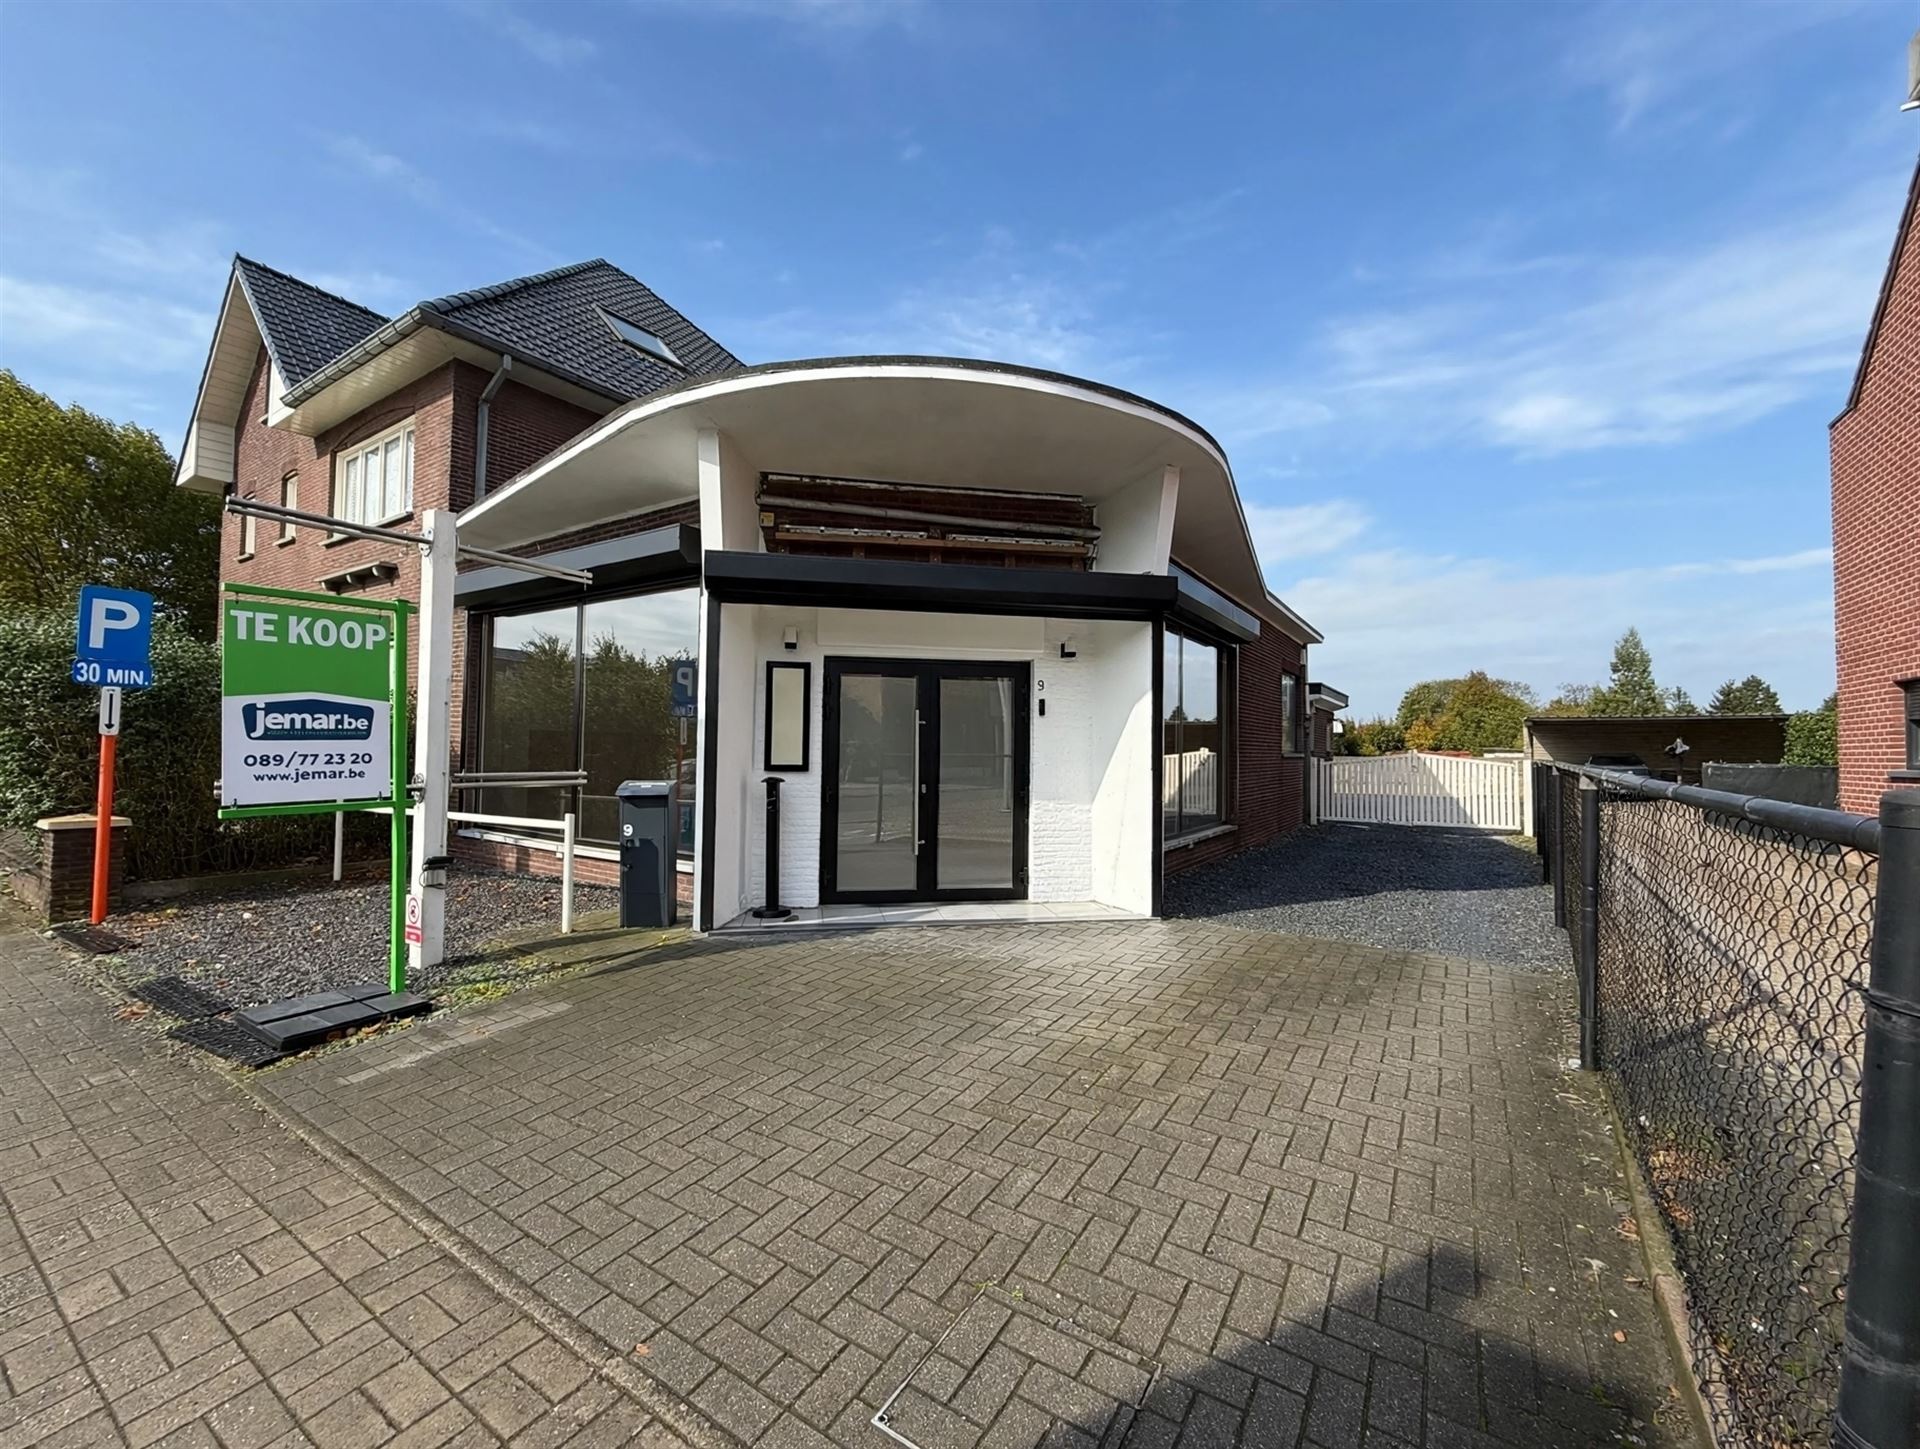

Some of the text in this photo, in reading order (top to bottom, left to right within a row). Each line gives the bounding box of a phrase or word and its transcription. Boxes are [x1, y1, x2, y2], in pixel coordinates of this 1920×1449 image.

[88, 597, 140, 649] P
[229, 609, 387, 650] TE KOOP
[76, 661, 149, 686] 30 MIN.
[1037, 679, 1045, 691] 9
[250, 701, 369, 738] jemar.be
[243, 751, 373, 768] 089/77 23 20
[253, 768, 366, 784] www.jemar.be
[623, 823, 634, 837] 9
